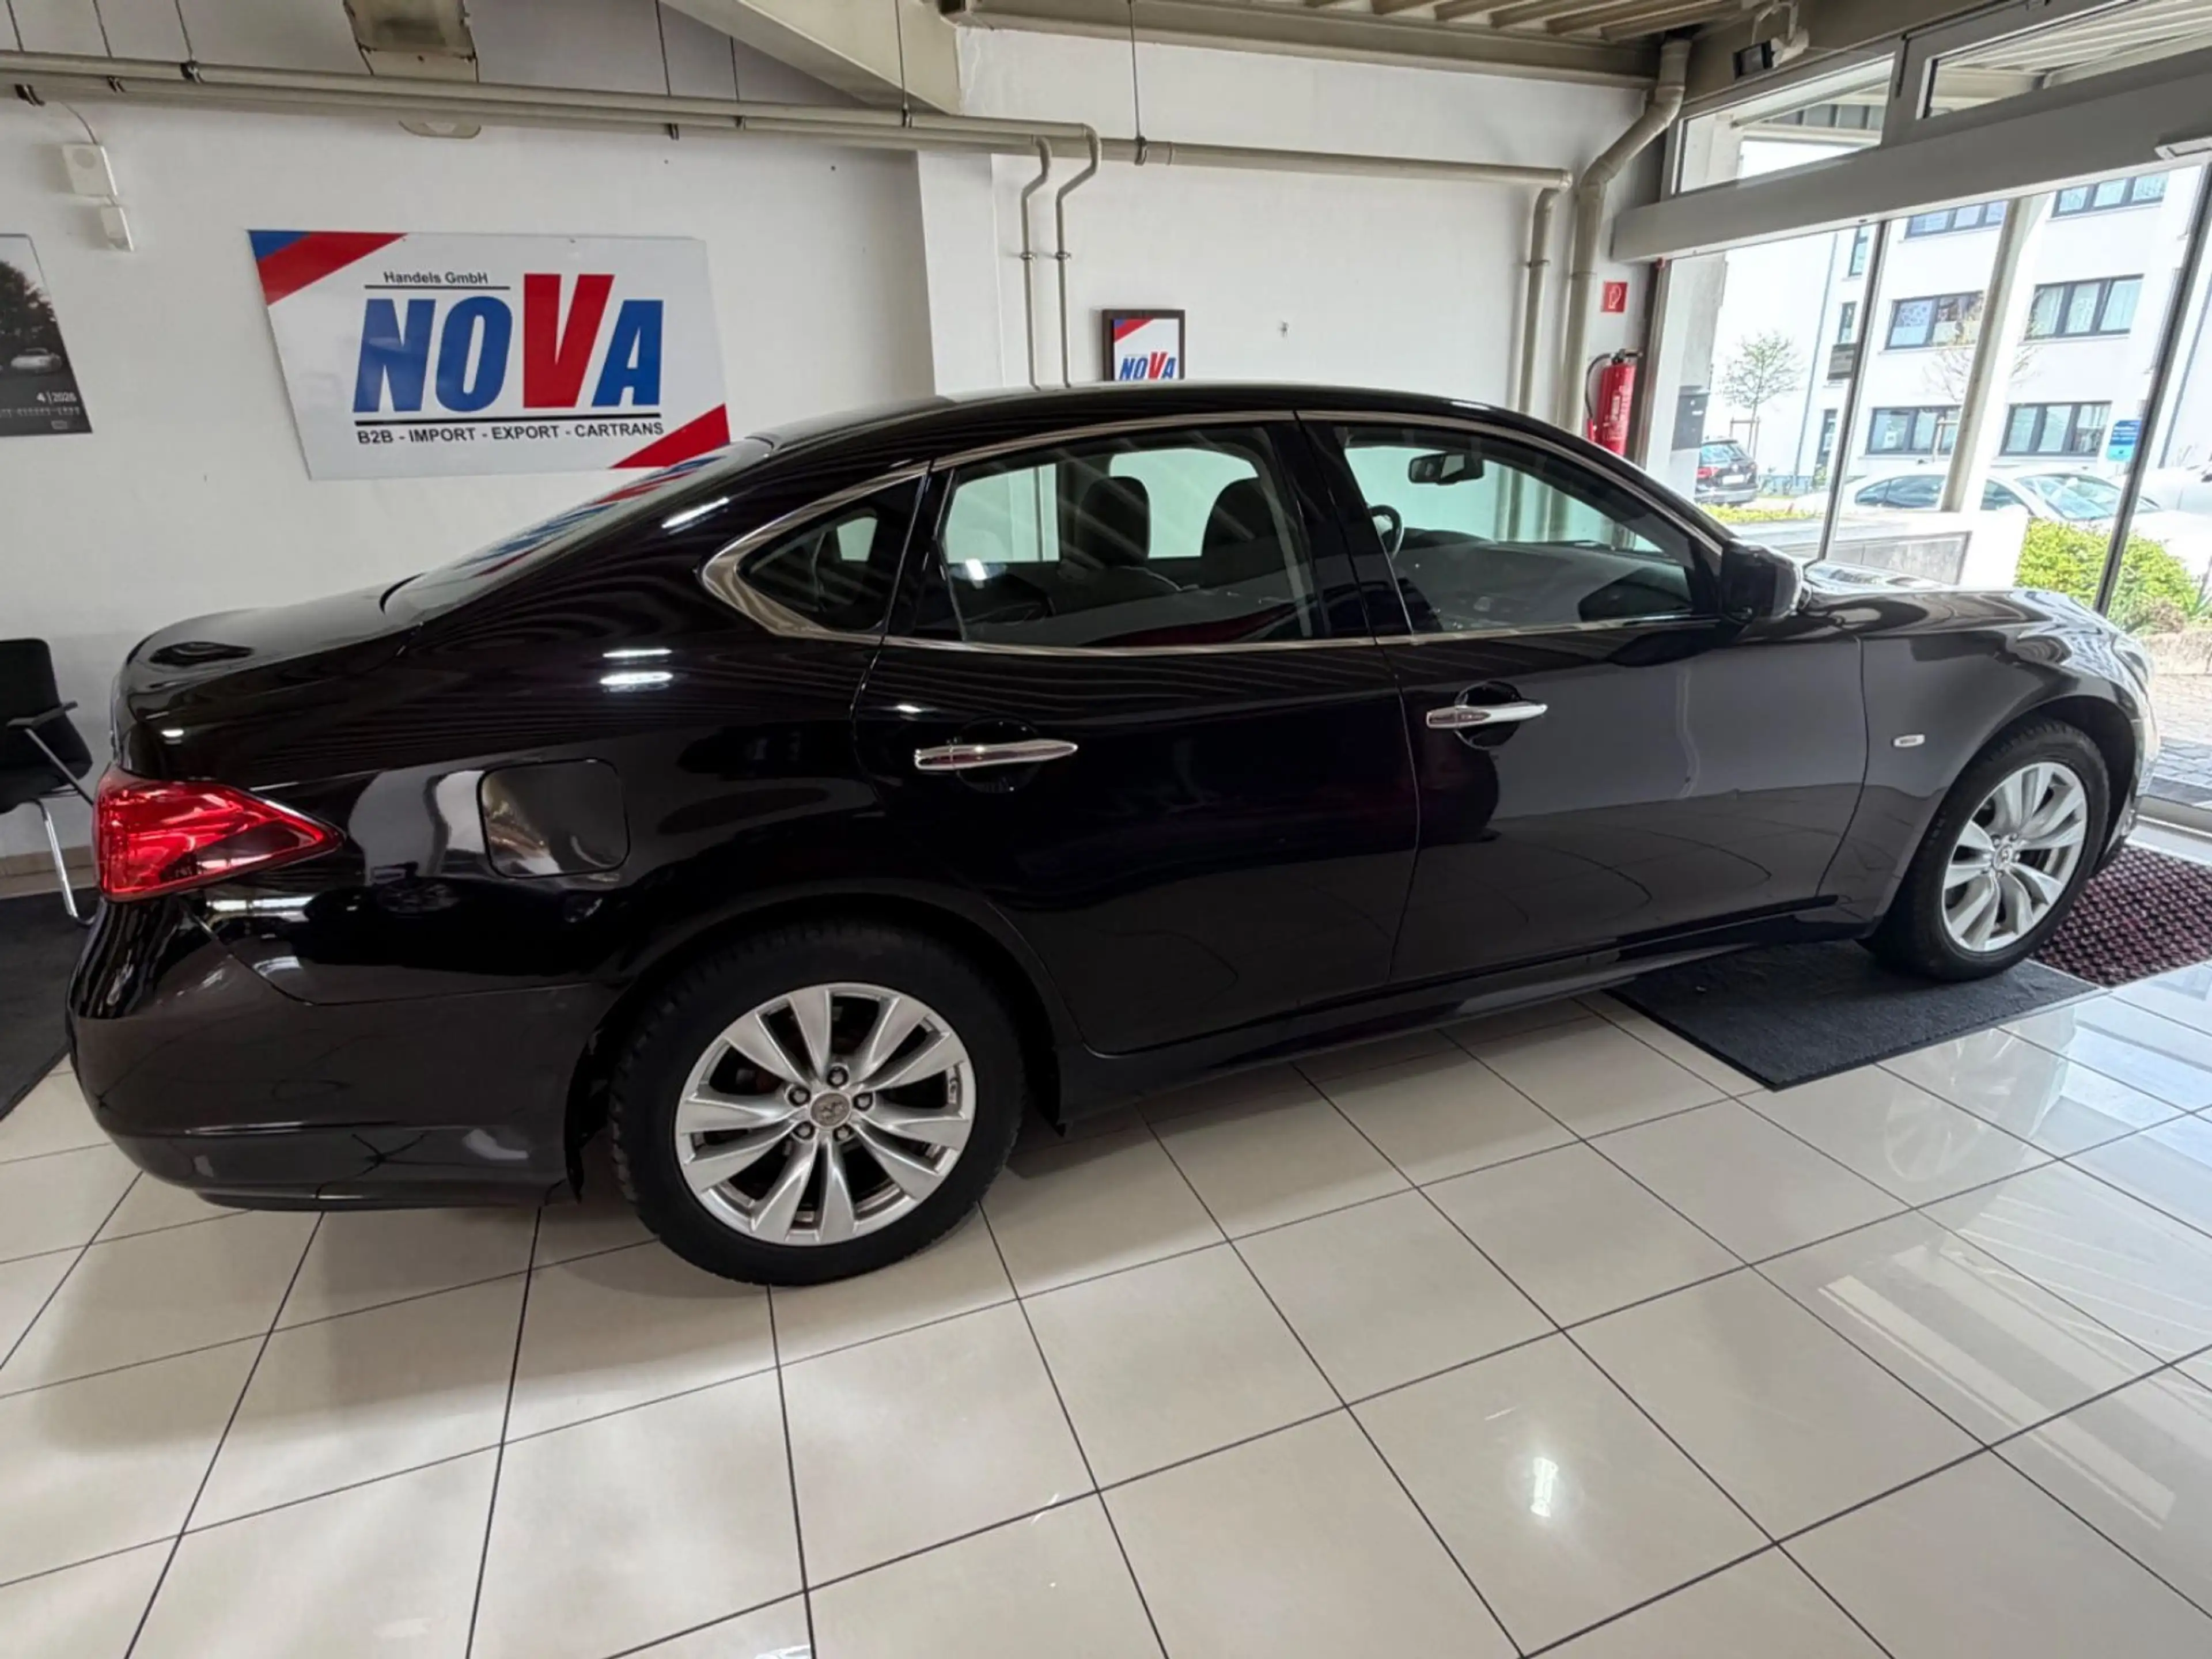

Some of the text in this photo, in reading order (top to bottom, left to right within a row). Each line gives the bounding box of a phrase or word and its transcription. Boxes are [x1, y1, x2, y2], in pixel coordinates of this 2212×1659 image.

[383, 271, 488, 284] Handels GmbH
[353, 274, 664, 412] NOVA
[1119, 351, 1176, 380] NOVA
[357, 430, 393, 444] B2B
[408, 427, 476, 442] IMPORT
[491, 425, 559, 441] EXPORT
[574, 422, 664, 438] CARTRANS
